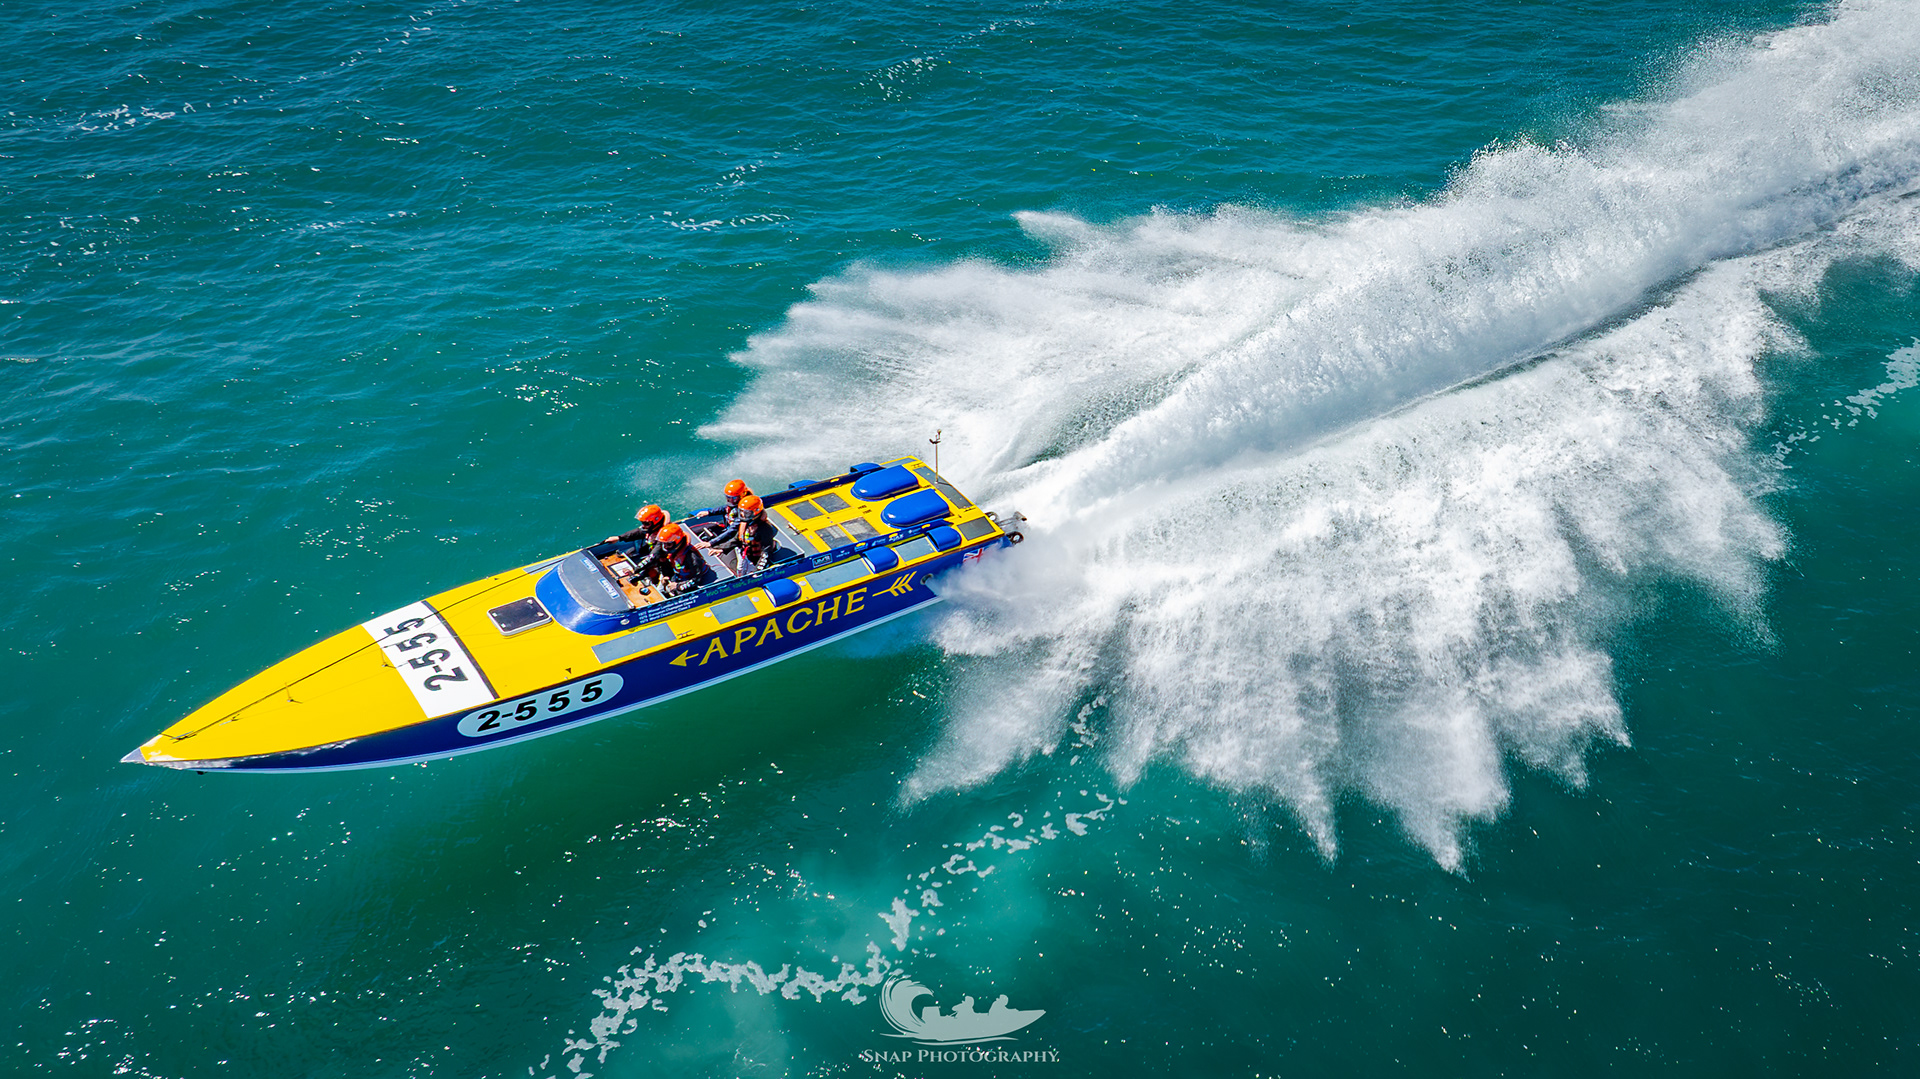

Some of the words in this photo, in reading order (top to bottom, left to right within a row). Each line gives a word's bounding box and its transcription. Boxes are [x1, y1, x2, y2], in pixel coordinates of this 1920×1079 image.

[383, 617, 469, 692] 2-555
[699, 587, 867, 666] APACHE
[477, 680, 603, 732] 2-555
